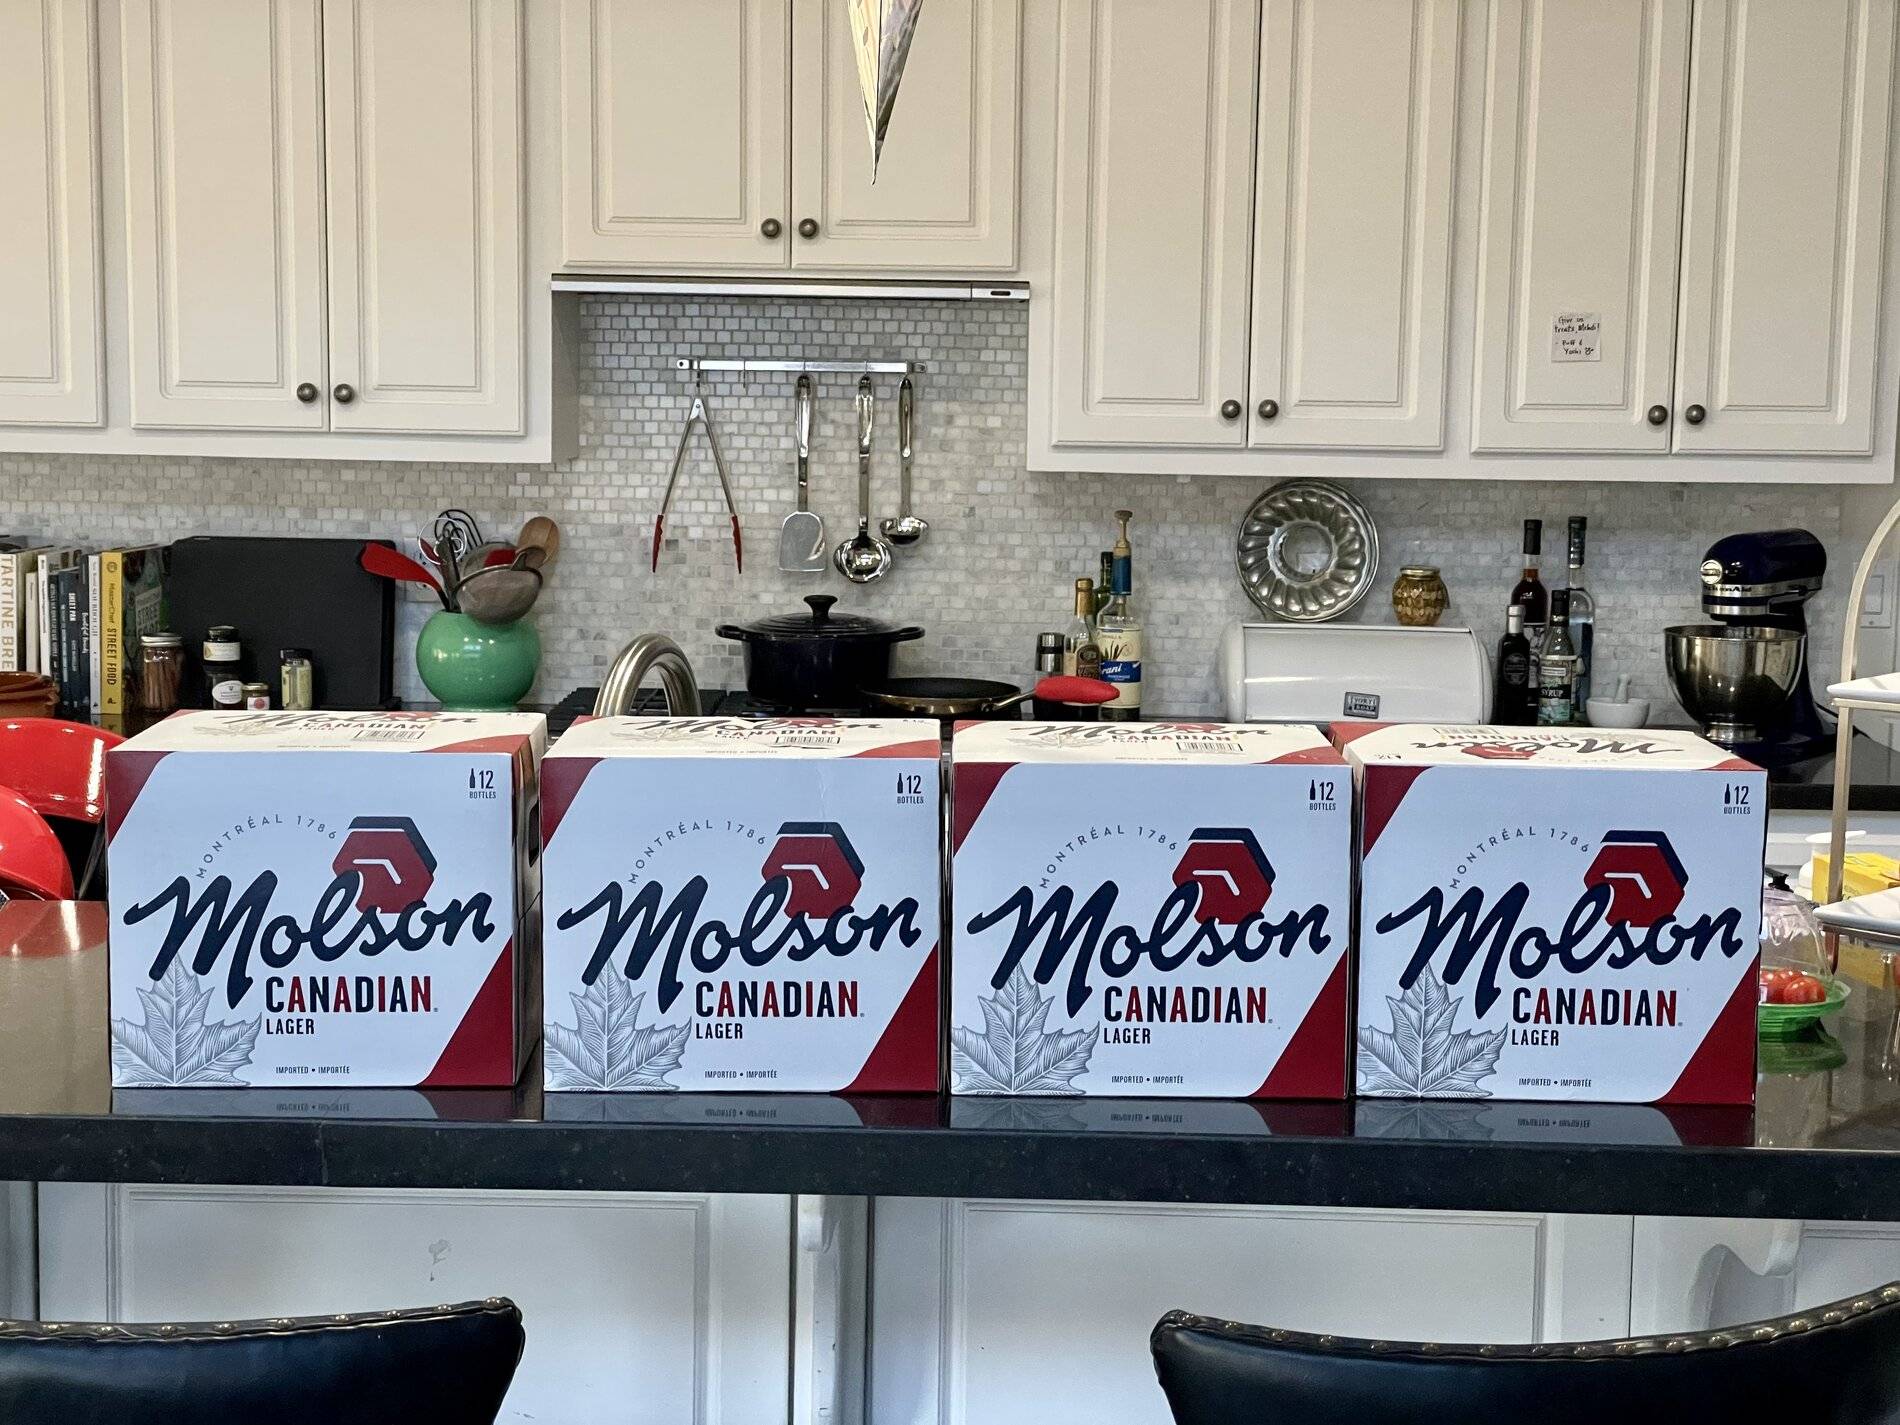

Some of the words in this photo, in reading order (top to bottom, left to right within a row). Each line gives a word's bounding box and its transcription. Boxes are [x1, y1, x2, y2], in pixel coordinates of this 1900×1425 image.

[0, 556, 15, 630] TARTINE
[108, 583, 117, 624] MasterChef
[106, 628, 118, 659] STREET
[106, 663, 117, 686] FOOD
[1540, 688, 1564, 698] SYRUP
[213, 712, 479, 727] Molson
[622, 718, 883, 733] Molson
[1010, 722, 1271, 738] Molson
[1409, 738, 1684, 754] Molson
[480, 770, 494, 789] 12
[907, 775, 922, 794] 12
[470, 791, 496, 799] BOTTLES
[896, 796, 924, 804] BOTTLES
[1319, 782, 1334, 801] 12
[1733, 786, 1750, 805] 12
[1309, 802, 1336, 812] BOTTLES
[1724, 806, 1750, 814] BOTTLES
[197, 813, 283, 878] MONTRÉAL
[297, 815, 336, 839] 1786
[628, 820, 713, 884] MONTRÉAL
[726, 821, 766, 845] 1786
[1040, 825, 1124, 888] MONTRÉAL
[1138, 826, 1178, 850] 1786
[1450, 826, 1536, 890] MONTRÉAL
[1550, 828, 1590, 853] 1786
[123, 870, 496, 1010] Molson
[556, 875, 922, 1014] Molson
[966, 880, 1331, 1020] Molson
[1375, 881, 1743, 1020] Molson
[265, 976, 432, 1014] CANADIAN
[696, 981, 859, 1018] CANADIAN
[1104, 986, 1266, 1024] CANADIAN
[1512, 988, 1677, 1026] CANADIAN
[266, 1018, 315, 1035] LAGER
[696, 1022, 743, 1040] LAGER
[1103, 1028, 1151, 1044] LAGER
[1511, 1030, 1560, 1046] LAGER
[276, 1066, 309, 1074] IMPORTED
[318, 1065, 350, 1074] IMPORTÉE
[704, 1071, 738, 1079] IMPORTED
[746, 1070, 778, 1079] IMPORTÉE
[1112, 1076, 1144, 1084] IMPORTED
[1152, 1075, 1184, 1084] IMPORTÉE
[1518, 1078, 1551, 1086] IMPORTED
[1560, 1078, 1592, 1088] IMPORTÉE
